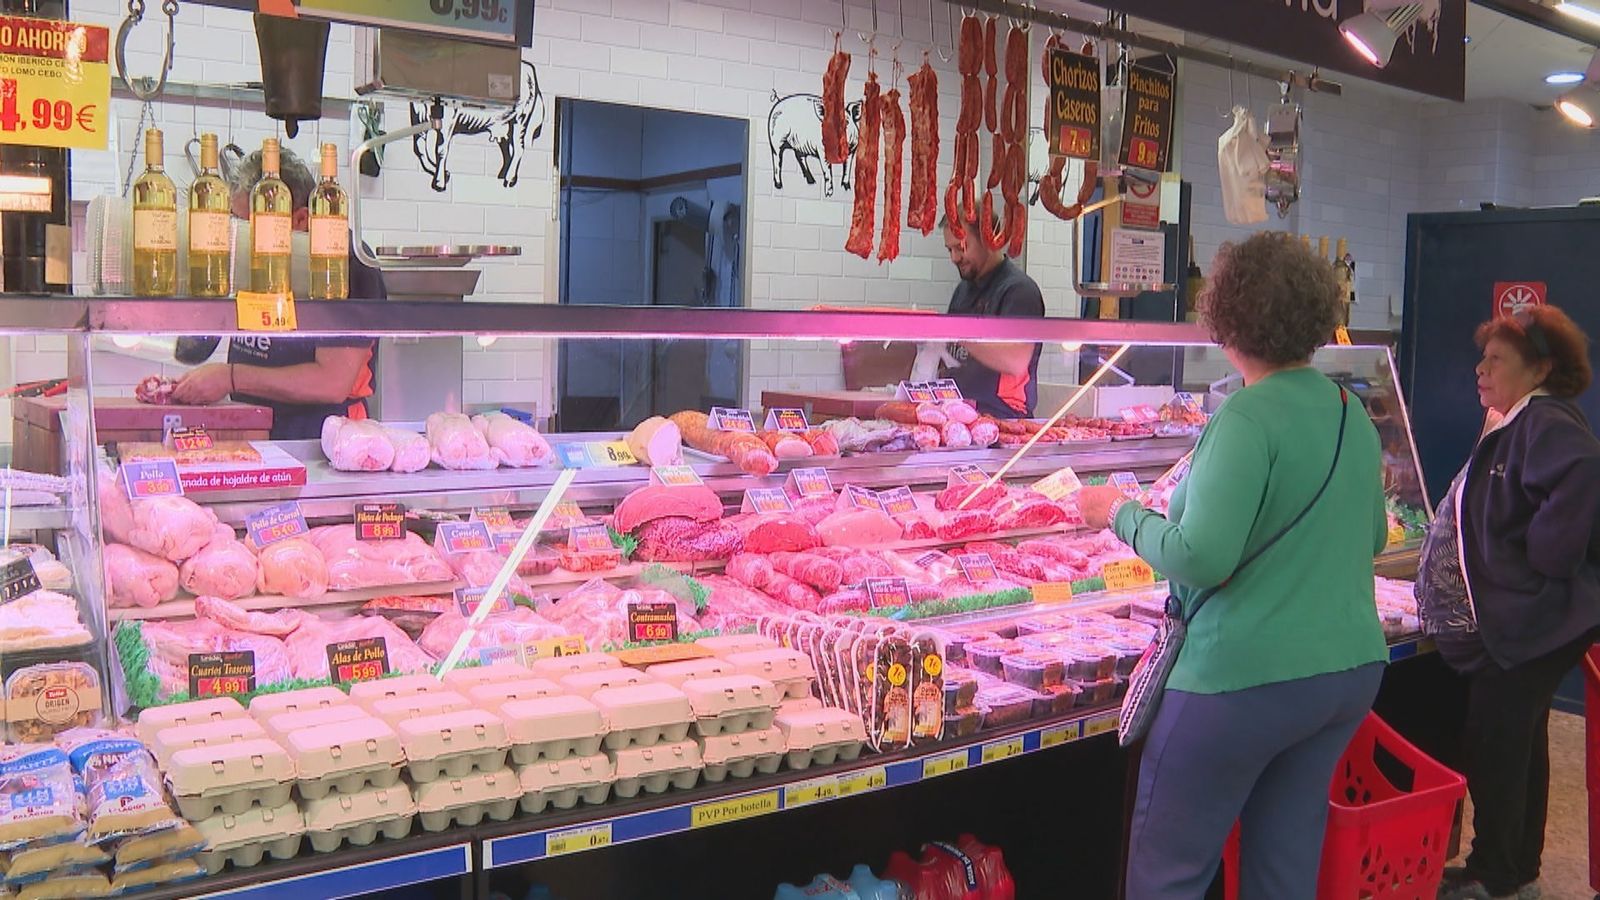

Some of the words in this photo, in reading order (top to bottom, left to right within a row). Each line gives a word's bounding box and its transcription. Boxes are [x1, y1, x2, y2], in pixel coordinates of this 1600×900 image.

[1053, 56, 1098, 92] Chorizos
[1129, 71, 1170, 99] Pinchitos
[1056, 90, 1097, 124] Caseros
[1138, 95, 1159, 113] para
[1133, 113, 1160, 138] Fritos
[141, 469, 164, 480] Pollo
[210, 474, 221, 485] de
[222, 473, 258, 489] hojaldre
[259, 473, 270, 483] de
[272, 472, 292, 482] atún
[251, 518, 270, 532] Pollo
[269, 515, 278, 526] de
[278, 509, 301, 524] Corral
[451, 527, 480, 539] Conejo
[332, 652, 351, 665] Alas
[352, 650, 362, 661] de
[364, 646, 385, 660] Pollo
[191, 664, 222, 677] Cuartos
[223, 663, 254, 675] Traseros
[45, 699, 70, 708] ORIGEN
[699, 809, 720, 822] PVP
[722, 806, 739, 817] Por
[741, 797, 772, 814] botella
